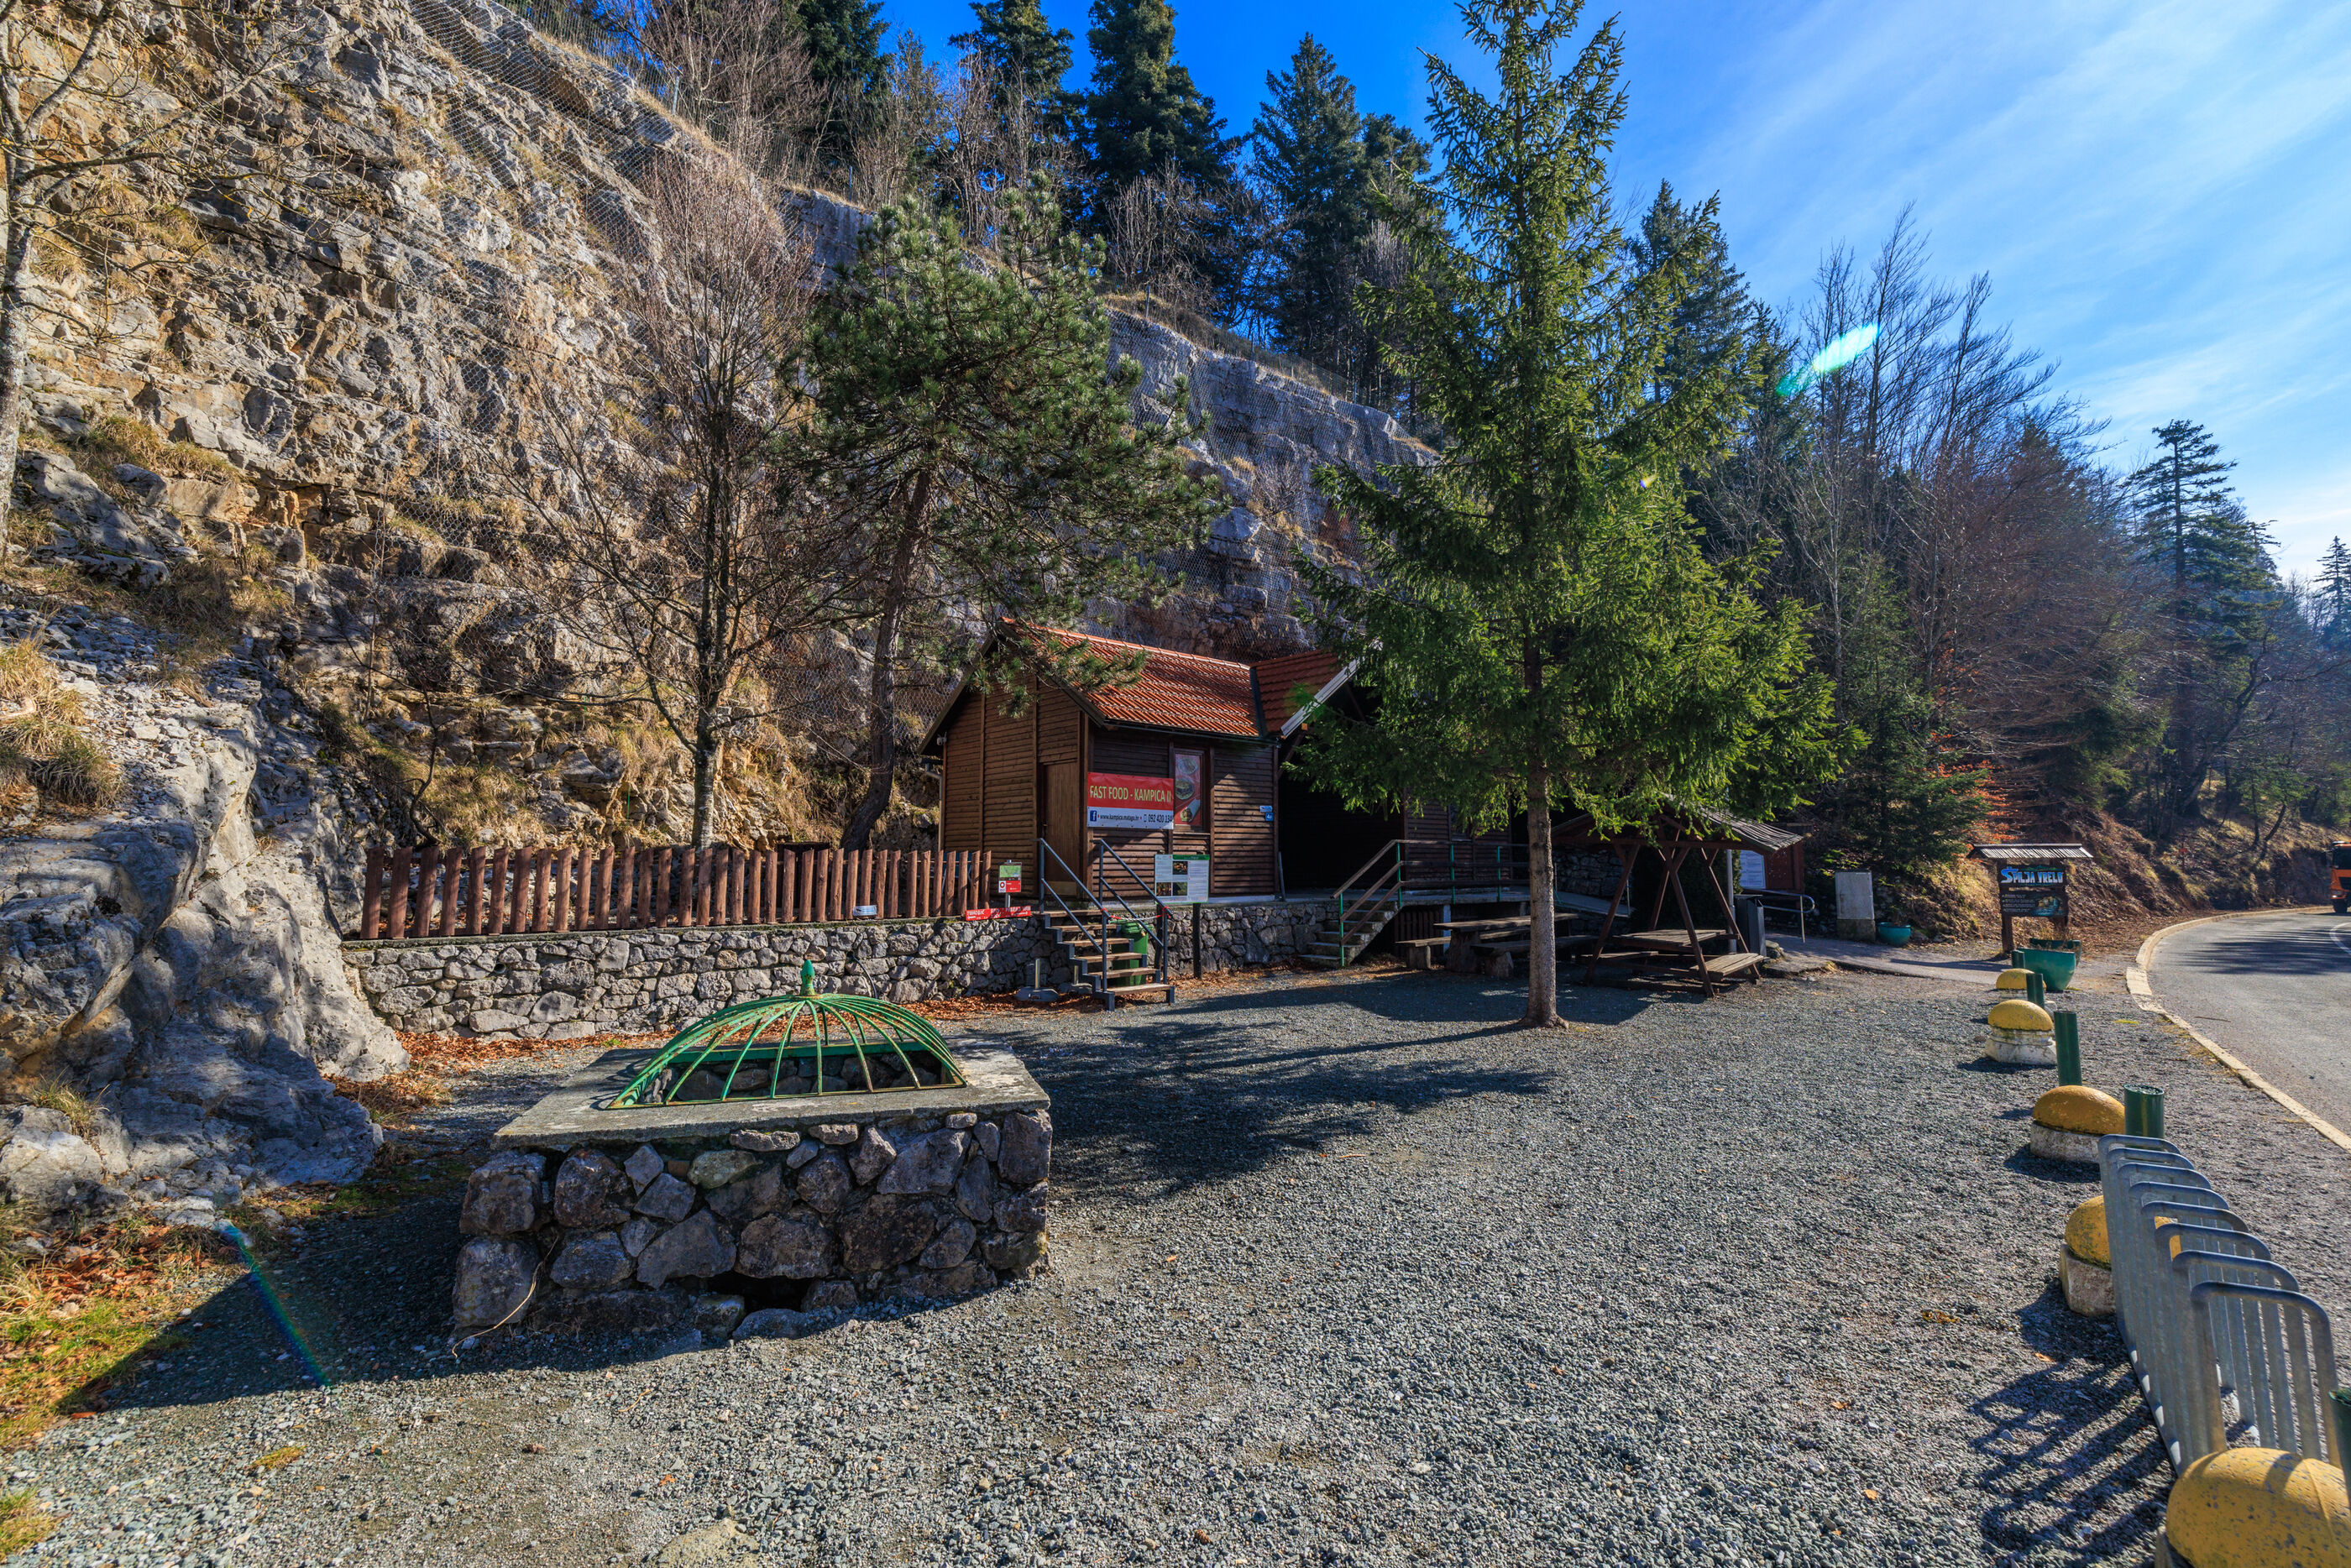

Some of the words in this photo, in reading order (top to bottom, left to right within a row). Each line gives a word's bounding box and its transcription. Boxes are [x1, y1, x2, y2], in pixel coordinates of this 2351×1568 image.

[1090, 785, 1107, 798] FAST
[1108, 786, 1128, 800] FOOD
[1134, 788, 1165, 802] KAMPICA
[2037, 871, 2064, 883] VRELO
